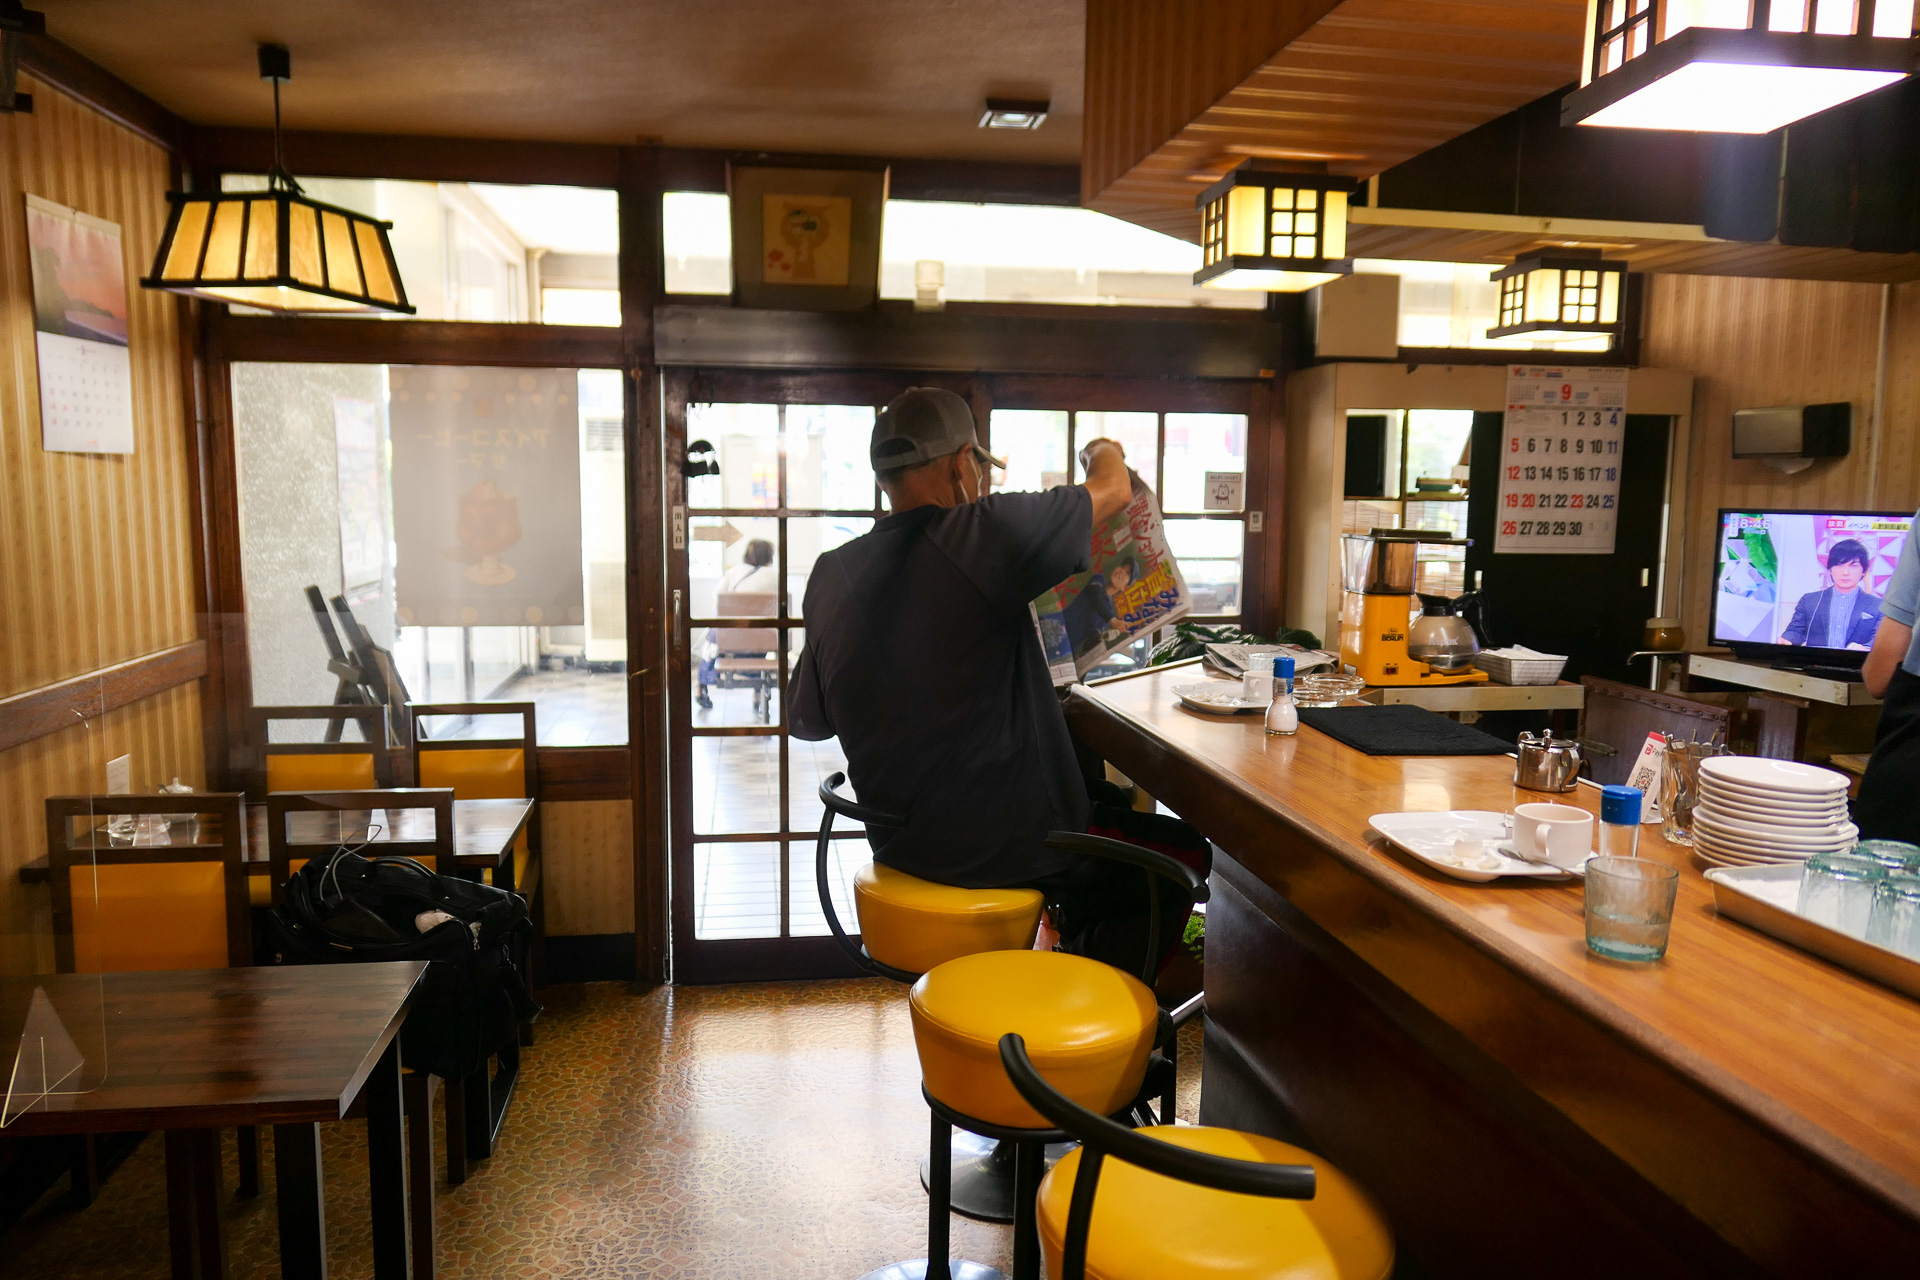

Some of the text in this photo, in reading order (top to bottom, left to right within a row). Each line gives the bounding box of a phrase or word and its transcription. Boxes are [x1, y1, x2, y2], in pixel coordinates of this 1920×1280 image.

[1561, 384, 1571, 400] 9
[1562, 412, 1568, 426] 1
[1577, 412, 1585, 426] 2
[1593, 412, 1601, 426] 3
[1609, 412, 1618, 426] 4
[1511, 438, 1618, 454] 5 6 7 8 9 10 11
[1508, 466, 1616, 482] 12 13 14 15 16 17 18
[1505, 494, 1614, 509] 19 20 21 22 23 24 25
[674, 513, 682, 544] 出入口
[1502, 521, 1517, 536] 26
[1520, 521, 1533, 536] 27
[1536, 522, 1550, 536] 28
[1553, 522, 1566, 536] 29
[1569, 522, 1582, 536] 30
[1740, 518, 1771, 530] 8:46
